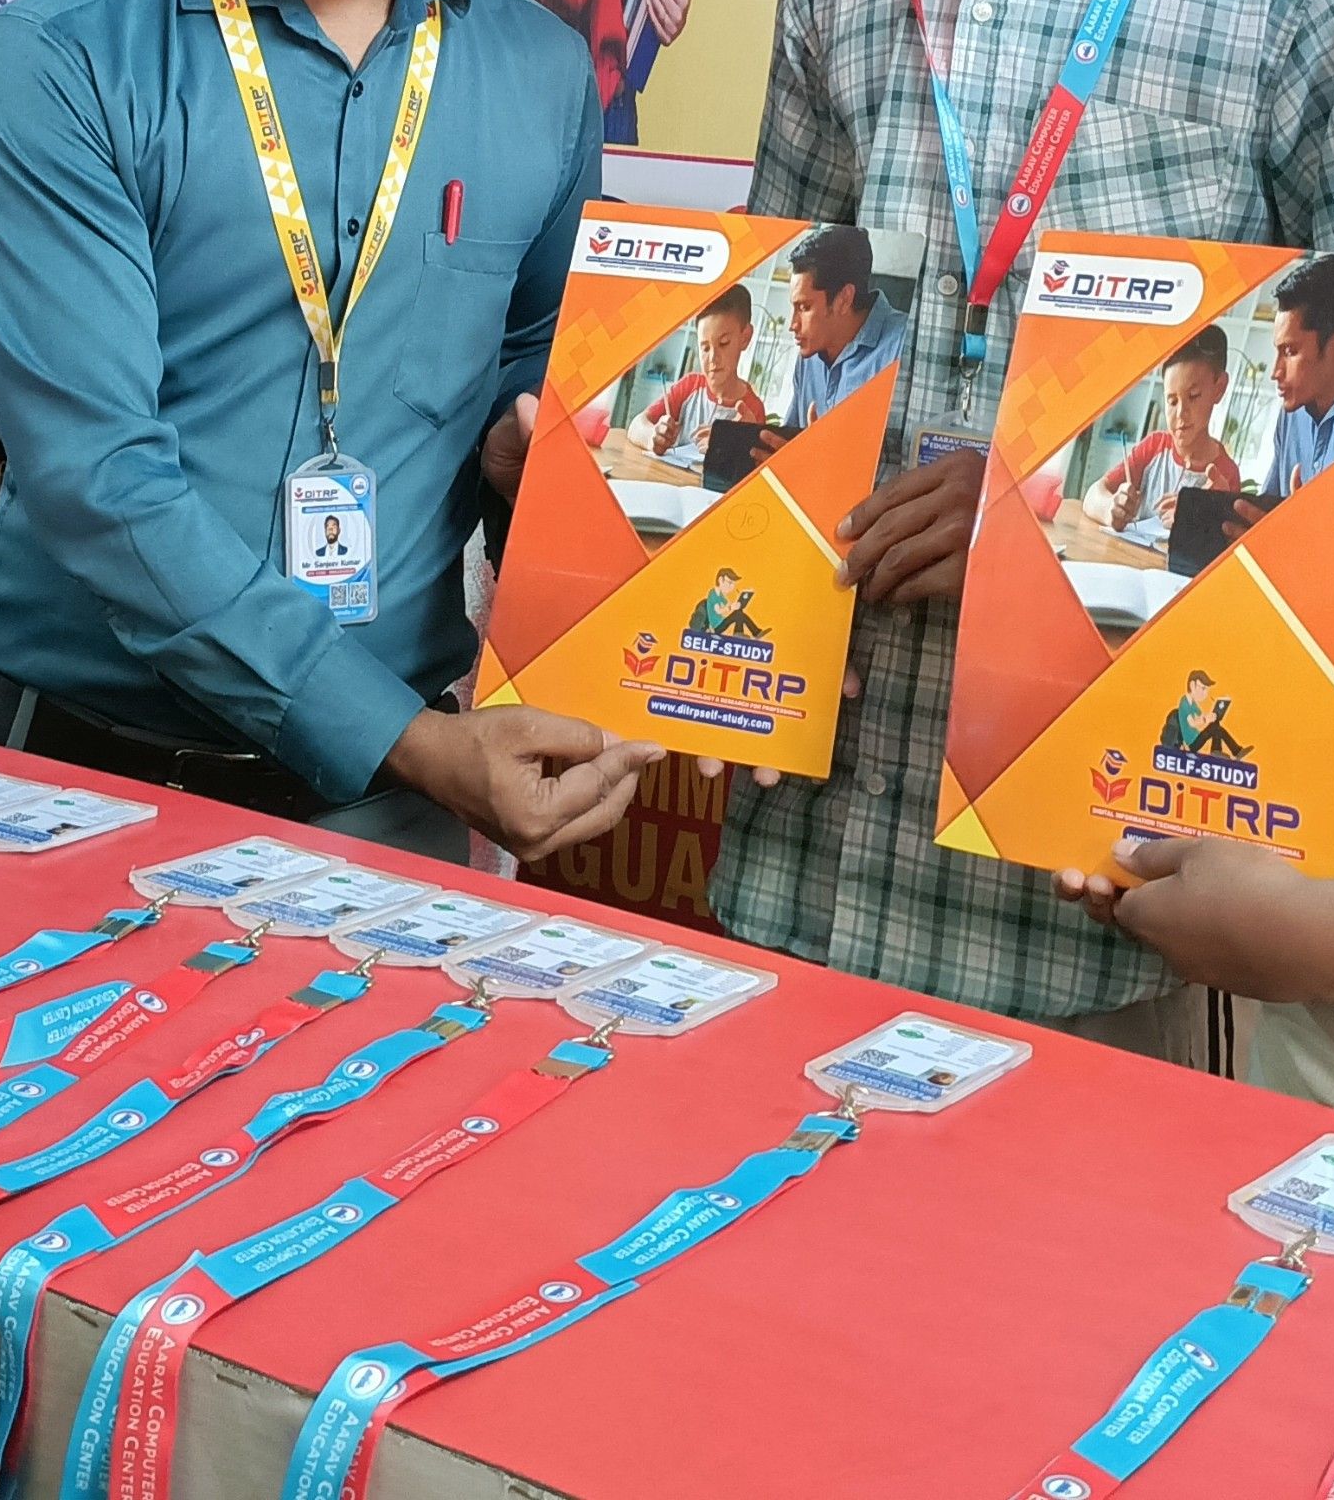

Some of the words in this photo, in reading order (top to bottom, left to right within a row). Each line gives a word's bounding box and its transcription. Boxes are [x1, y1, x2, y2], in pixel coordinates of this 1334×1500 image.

[1019, 150, 1043, 188] AARAV
[1031, 107, 1059, 155] COMPUTER
[1027, 141, 1056, 196] EDUCATION
[1049, 110, 1073, 145] CENTER
[683, 635, 771, 662] SELF-STUDY
[1156, 754, 1255, 787] SELF-STUDY
[127, 1327, 163, 1430] EDUCATION
[151, 1336, 176, 1401] AARAV
[1135, 1347, 1189, 1408] EDUCATION
[1165, 1365, 1205, 1405] AARAV
[1099, 1399, 1145, 1439] CENTER
[1126, 1393, 1181, 1445] COMPUTER
[120, 1436, 140, 1500] CENTER
[141, 1405, 166, 1500] COMPUTER
